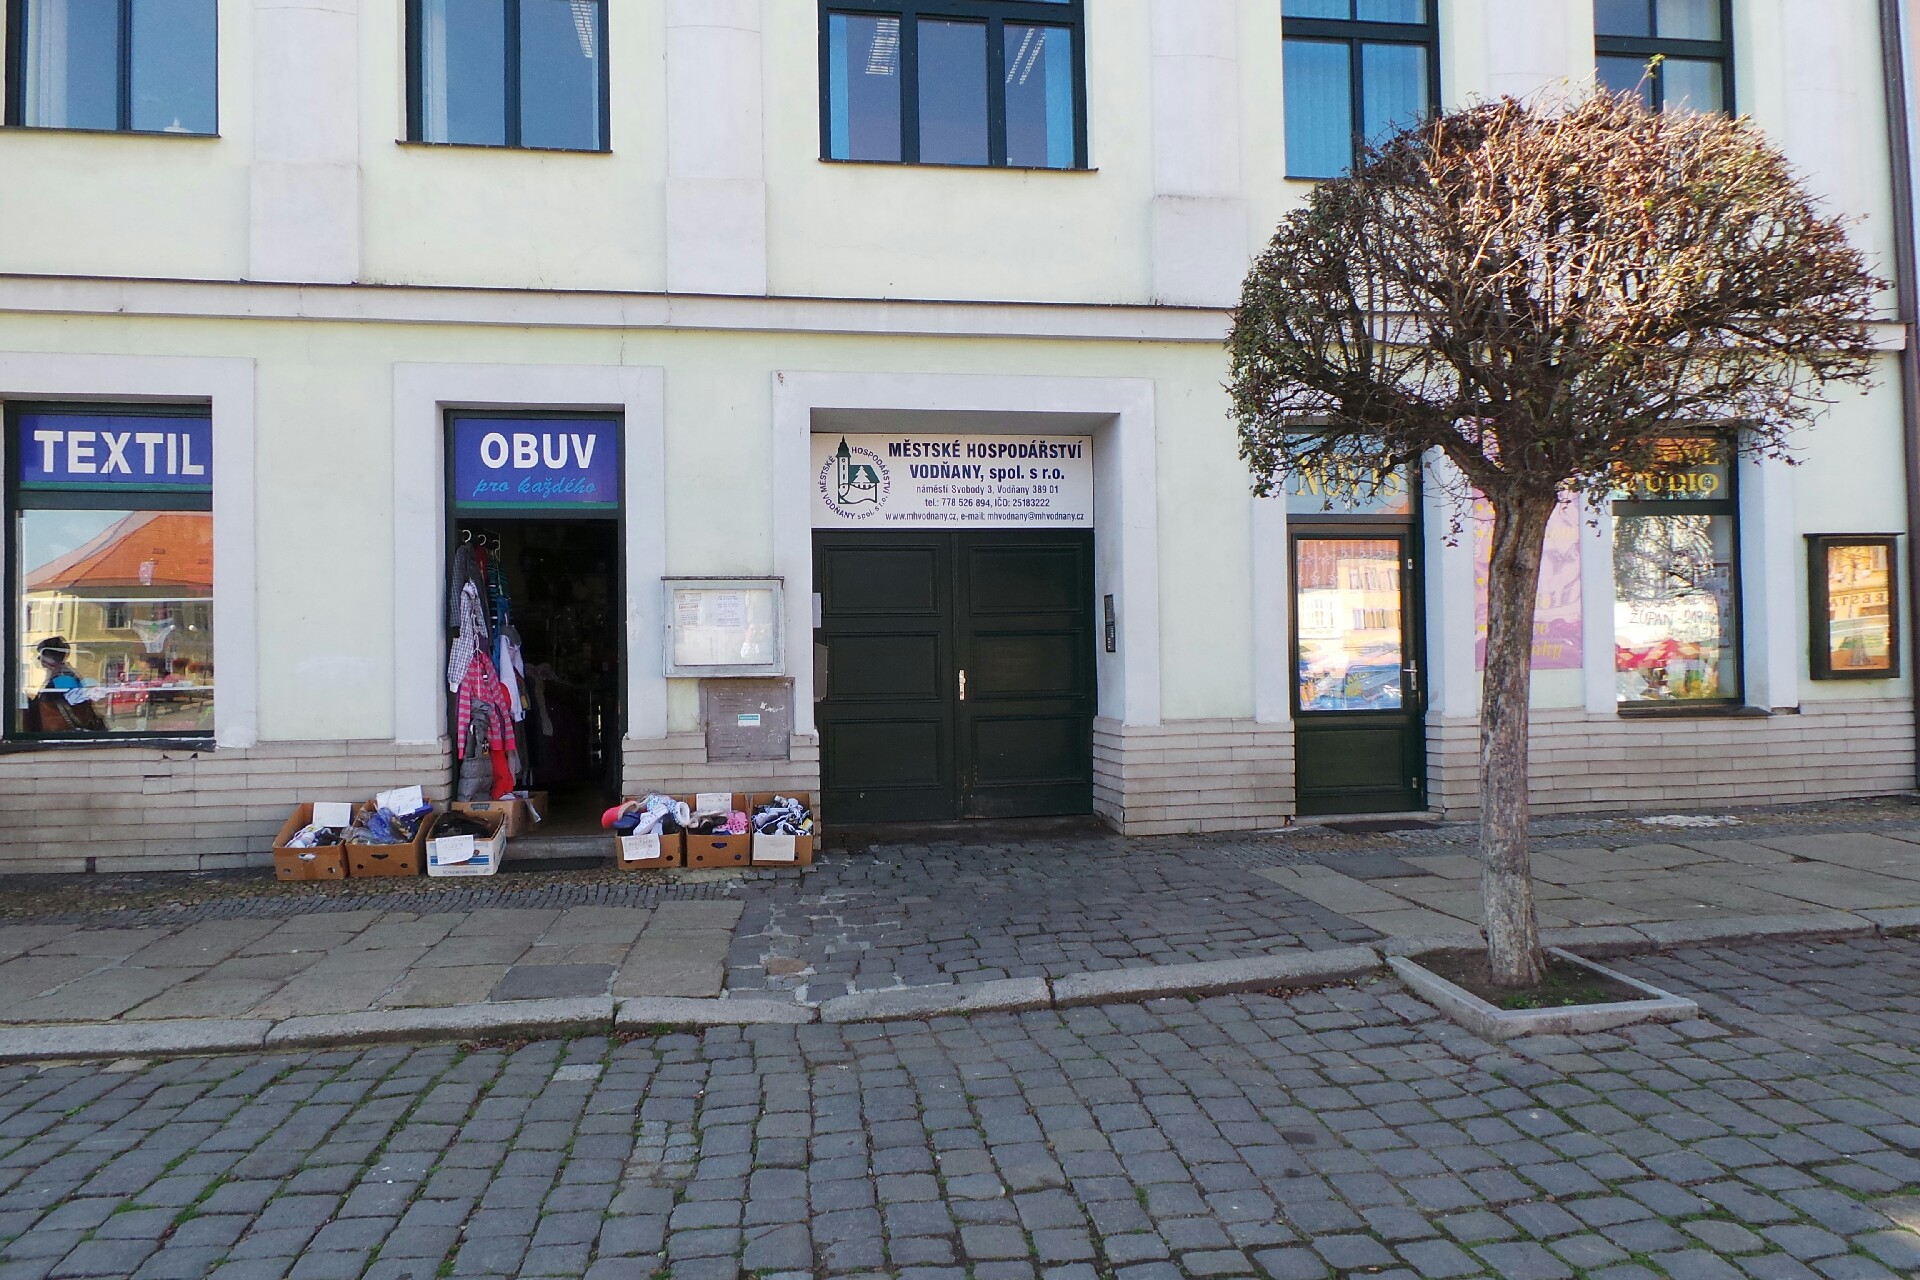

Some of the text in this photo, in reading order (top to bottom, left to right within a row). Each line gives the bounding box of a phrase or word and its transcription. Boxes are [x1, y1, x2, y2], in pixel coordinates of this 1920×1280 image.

[34, 430, 205, 475] TEXTIL
[480, 432, 597, 469] OBUV
[889, 439, 1083, 459] MĚSTSKÉ HOSPODÁŘSTVÍ
[818, 446, 891, 494] MĚSTSKÉ HOSPODÁŘSTVÍ
[909, 461, 1065, 482] VODŇANY, spol. s r.o.
[473, 475, 597, 499] pro každého
[916, 484, 1059, 495] náměstí Svobody 3, Vodňany 389 01
[1614, 473, 1719, 492] TUDIO
[822, 494, 856, 520] VODŇANY
[925, 498, 939, 507] tel.:
[941, 498, 956, 507] 778
[958, 498, 973, 507] 526
[975, 498, 993, 508] 894,
[1012, 498, 1050, 507] 25183222
[885, 511, 959, 522] www.mhvodnany.cz,
[987, 511, 1085, 522] mhvodnany@mhvodnany.cz
